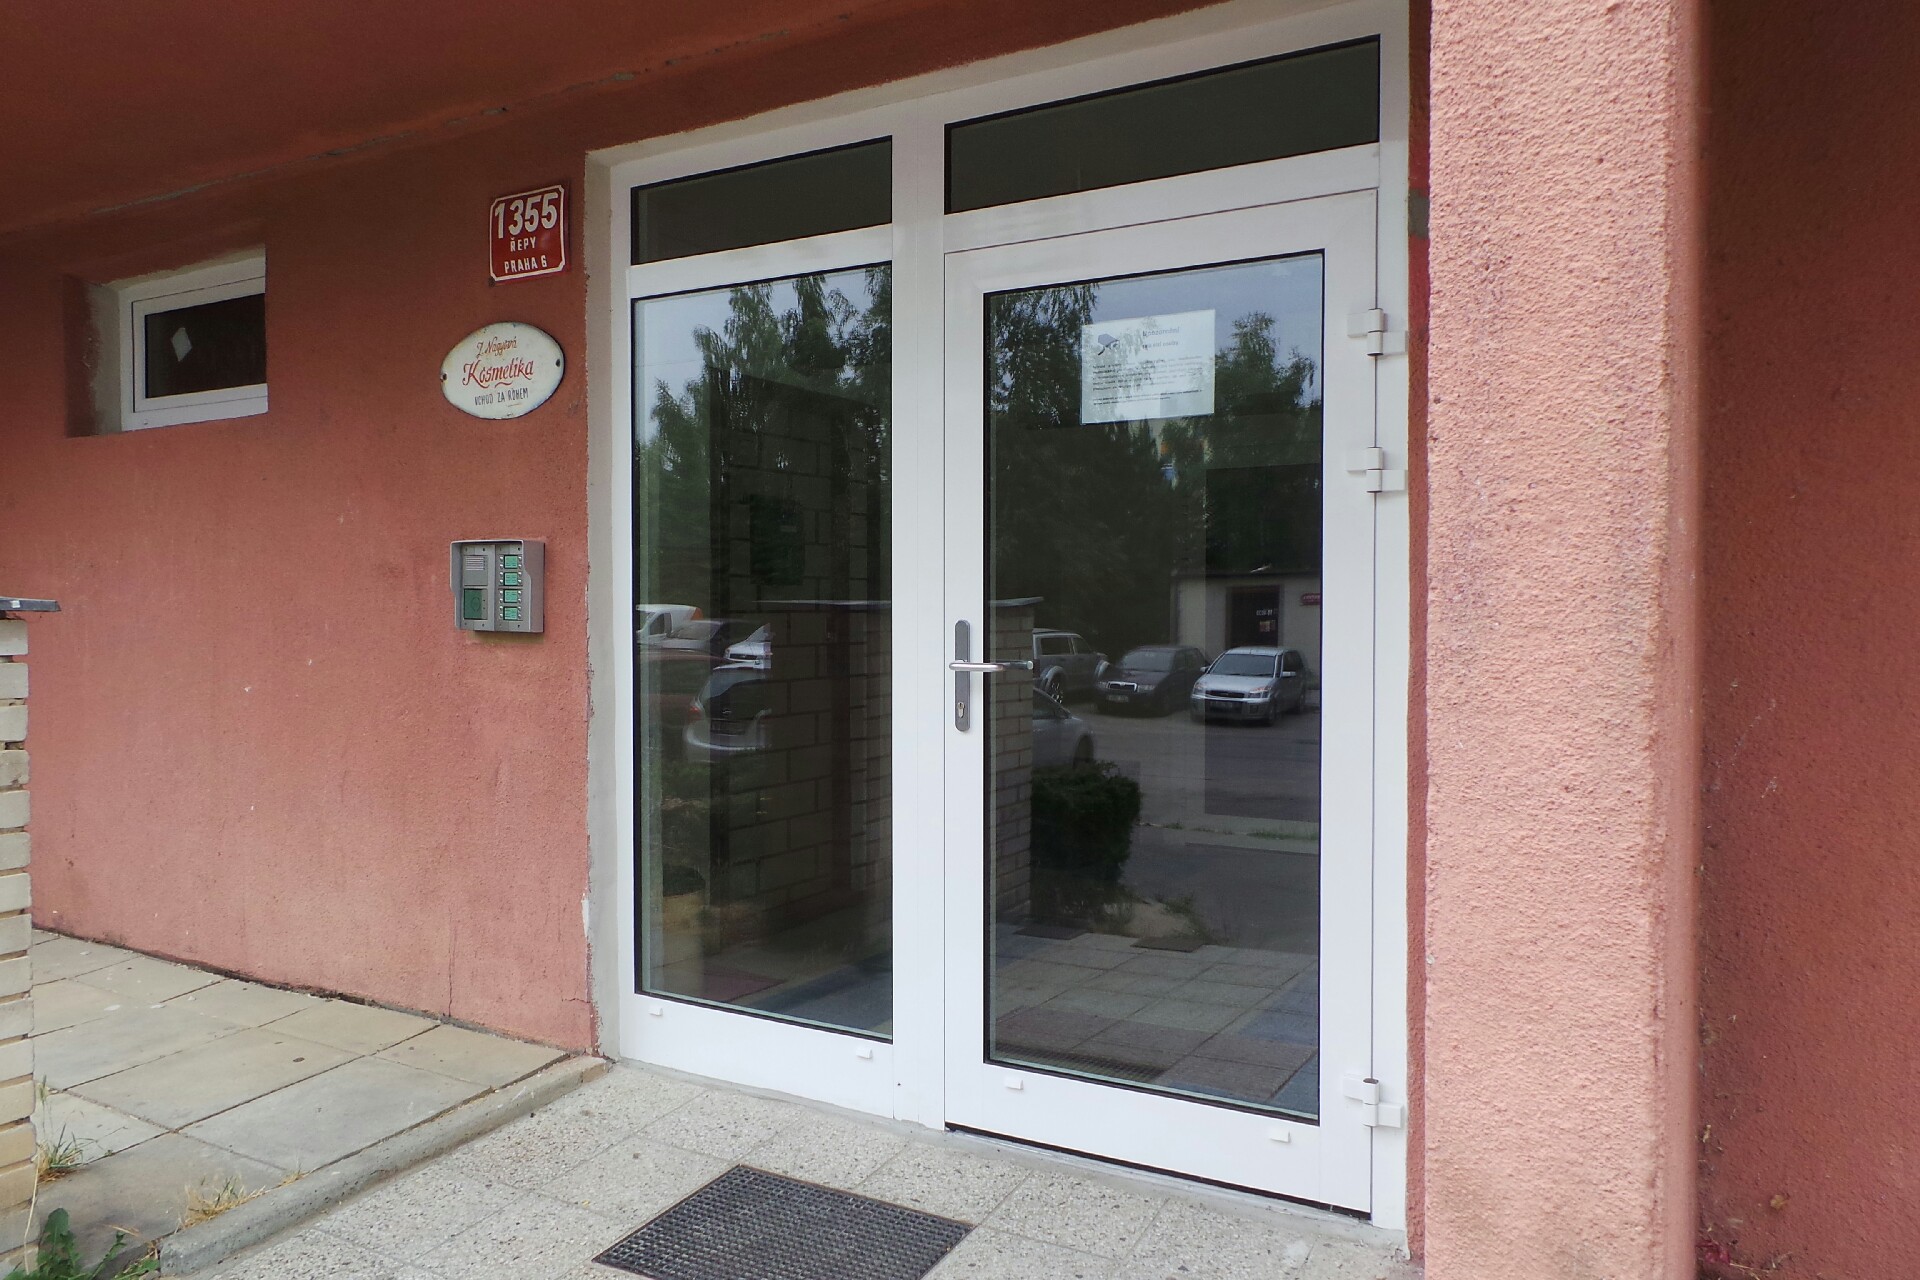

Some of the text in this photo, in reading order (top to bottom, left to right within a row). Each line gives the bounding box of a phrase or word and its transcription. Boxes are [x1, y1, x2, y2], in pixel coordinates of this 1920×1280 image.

[495, 192, 559, 239] 1355
[510, 236, 537, 252] ŘEPY
[504, 254, 548, 274] PRAHA 6
[462, 357, 534, 389] Kosmetika
[497, 391, 506, 403] ZA
